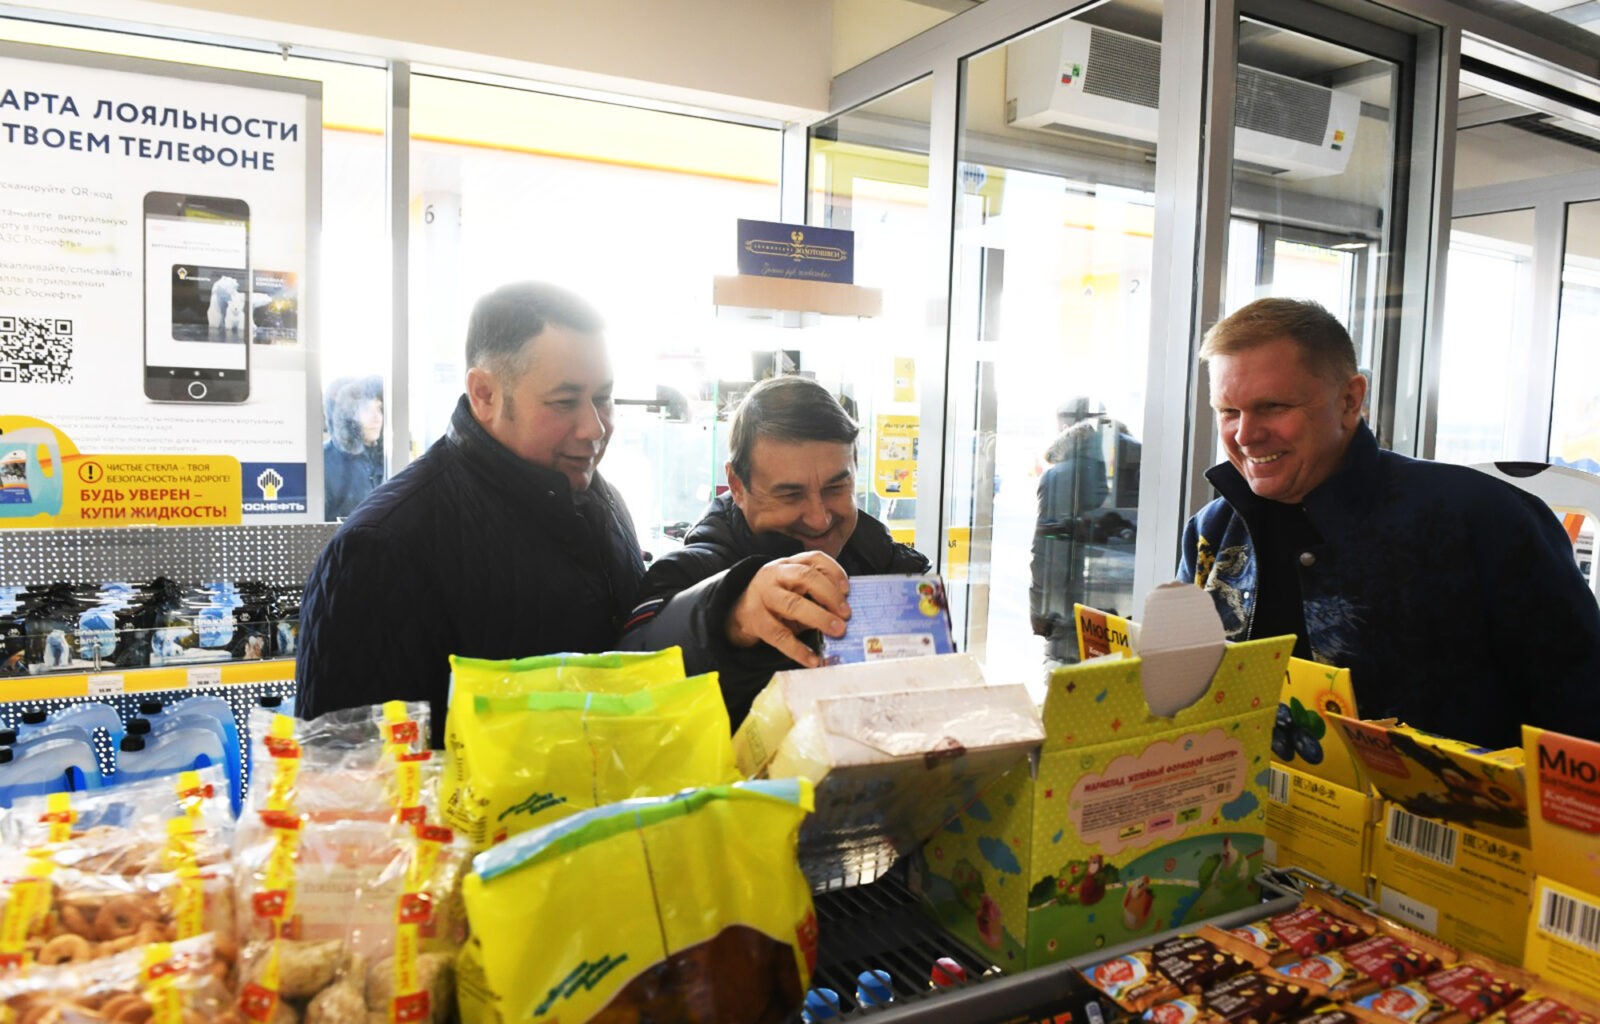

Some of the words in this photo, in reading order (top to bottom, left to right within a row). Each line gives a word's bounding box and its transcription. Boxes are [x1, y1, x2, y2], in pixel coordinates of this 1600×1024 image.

[93, 99, 298, 142] ЛОЯЛЬНОСТИ
[2, 122, 110, 154] ТВОЕМ
[119, 135, 275, 171] ТЕЛЕФОНЕ
[0, 181, 66, 195] сканируйте
[71, 186, 113, 200] QR-код
[0, 208, 52, 219] тановите
[57, 212, 129, 227] виртуальную
[424, 203, 435, 225] 6
[32, 224, 102, 237] приложении
[36, 277, 105, 290] приложении
[1129, 279, 1141, 294] 2
[106, 463, 144, 472] ЧИСТЫЕ
[145, 463, 179, 472] СТЕКЛА
[187, 463, 210, 472] ТВОЯ
[106, 474, 178, 484] БЕЗОПАСНОСТЬ
[179, 475, 193, 483] НА
[193, 474, 231, 484] ДОРОГЕ!
[80, 489, 125, 504] БУДЬ
[128, 488, 190, 502] УВЕРЕН
[80, 506, 126, 520] КУПИ
[129, 505, 228, 521] ЖИДКОСТЬ!
[1081, 614, 1129, 649] Мюсли
[1538, 743, 1600, 784] Мю
